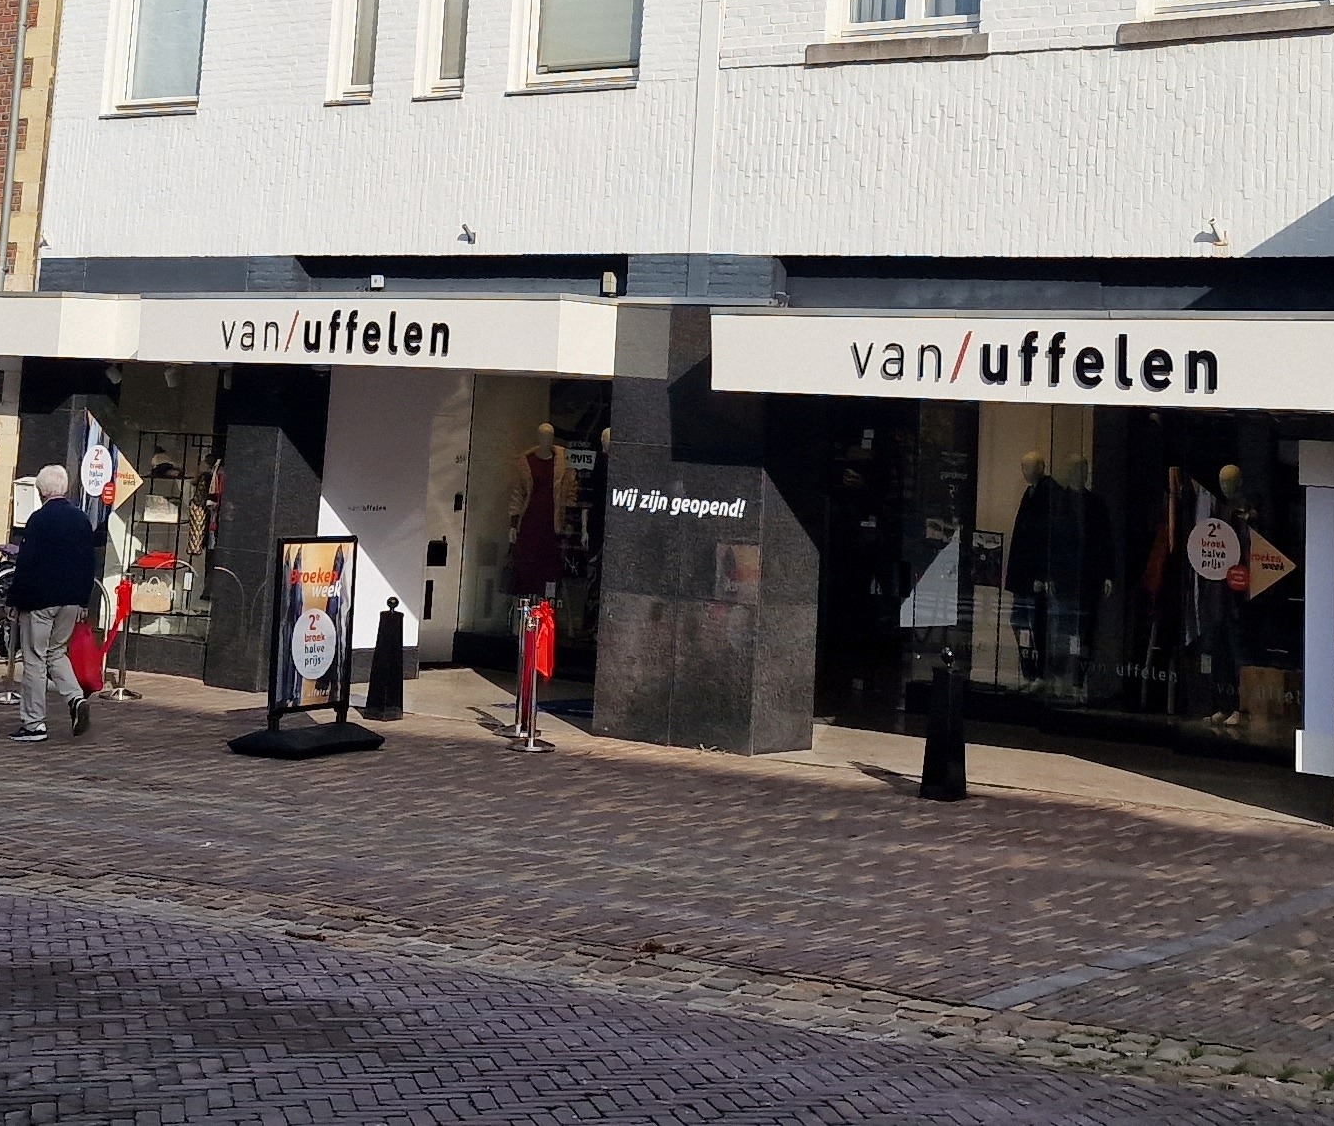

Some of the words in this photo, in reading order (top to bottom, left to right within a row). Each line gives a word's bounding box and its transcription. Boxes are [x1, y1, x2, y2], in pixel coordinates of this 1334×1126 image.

[612, 488, 638, 512] Wij
[639, 490, 668, 513] zijn
[670, 497, 747, 519] geopend!
[311, 583, 342, 598] week
[305, 633, 326, 643] broek
[304, 644, 325, 654] halve
